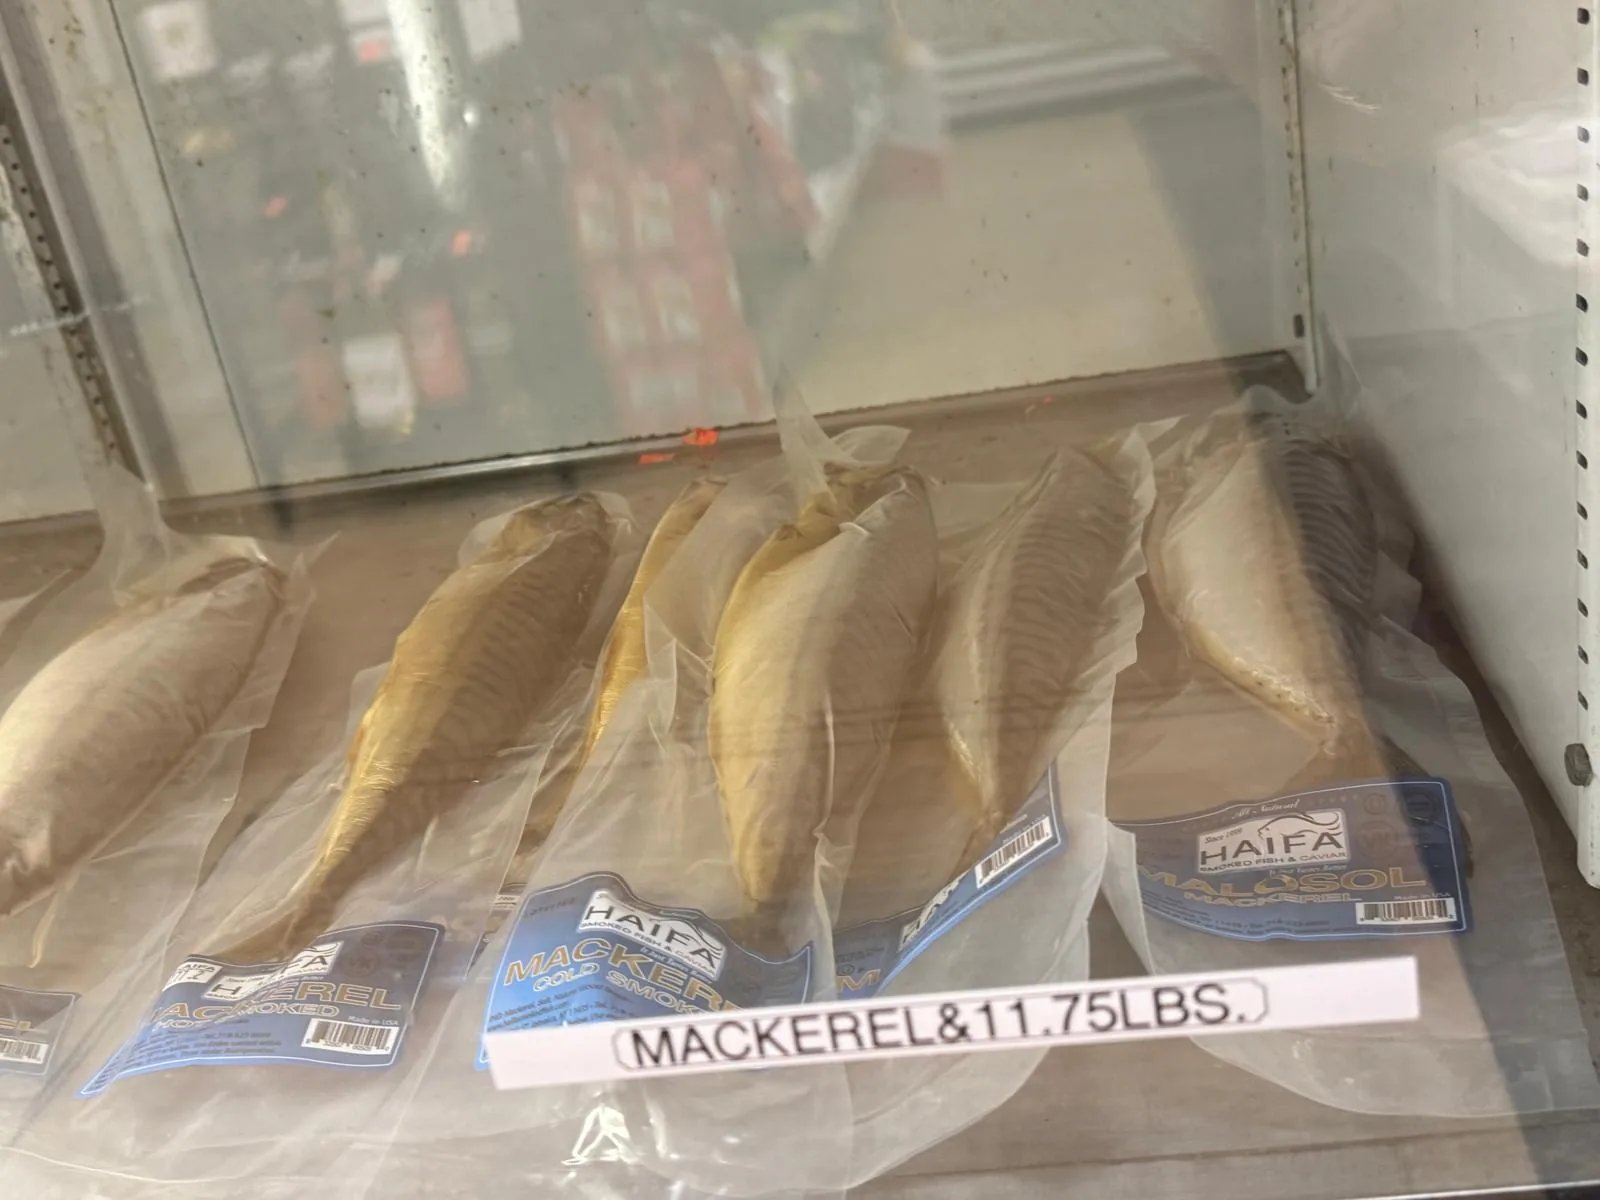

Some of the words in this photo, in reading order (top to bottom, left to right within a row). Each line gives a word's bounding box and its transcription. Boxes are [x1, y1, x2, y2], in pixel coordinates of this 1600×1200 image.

[1199, 859, 1253, 873] SMOKED
[1255, 856, 1285, 866] FISH
[1287, 856, 1297, 864] &
[1299, 851, 1346, 862] CAVIAR
[1200, 831, 1345, 866] HAIFA
[580, 920, 632, 935] SMOKED
[584, 905, 717, 969] HAIFA
[503, 937, 743, 1012] MACKER
[533, 962, 601, 992] COLD
[606, 969, 707, 1015] SMOK
